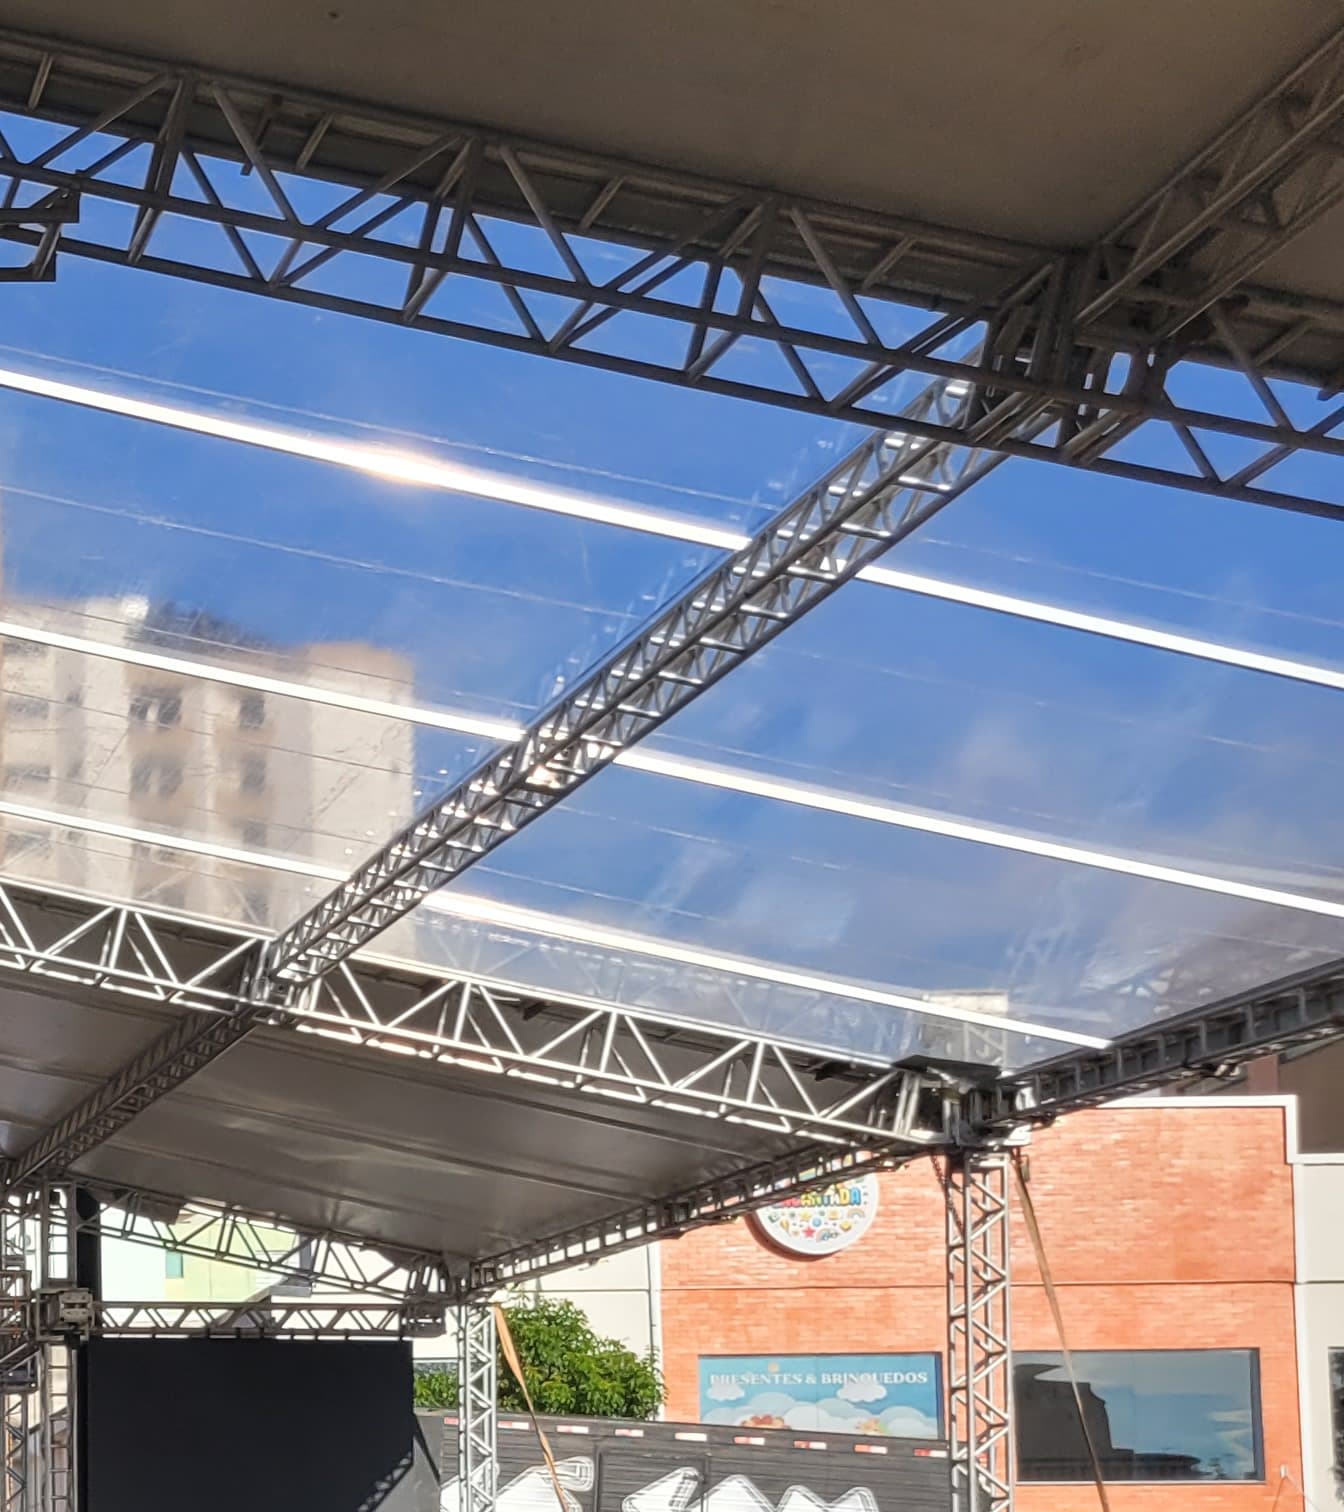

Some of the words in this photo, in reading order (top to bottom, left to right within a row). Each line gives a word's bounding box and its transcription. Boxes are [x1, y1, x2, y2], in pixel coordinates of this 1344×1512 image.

[710, 1373, 803, 1385] PRESENTES
[805, 1373, 817, 1384] &
[821, 1371, 928, 1385] BRINQUEDOS
